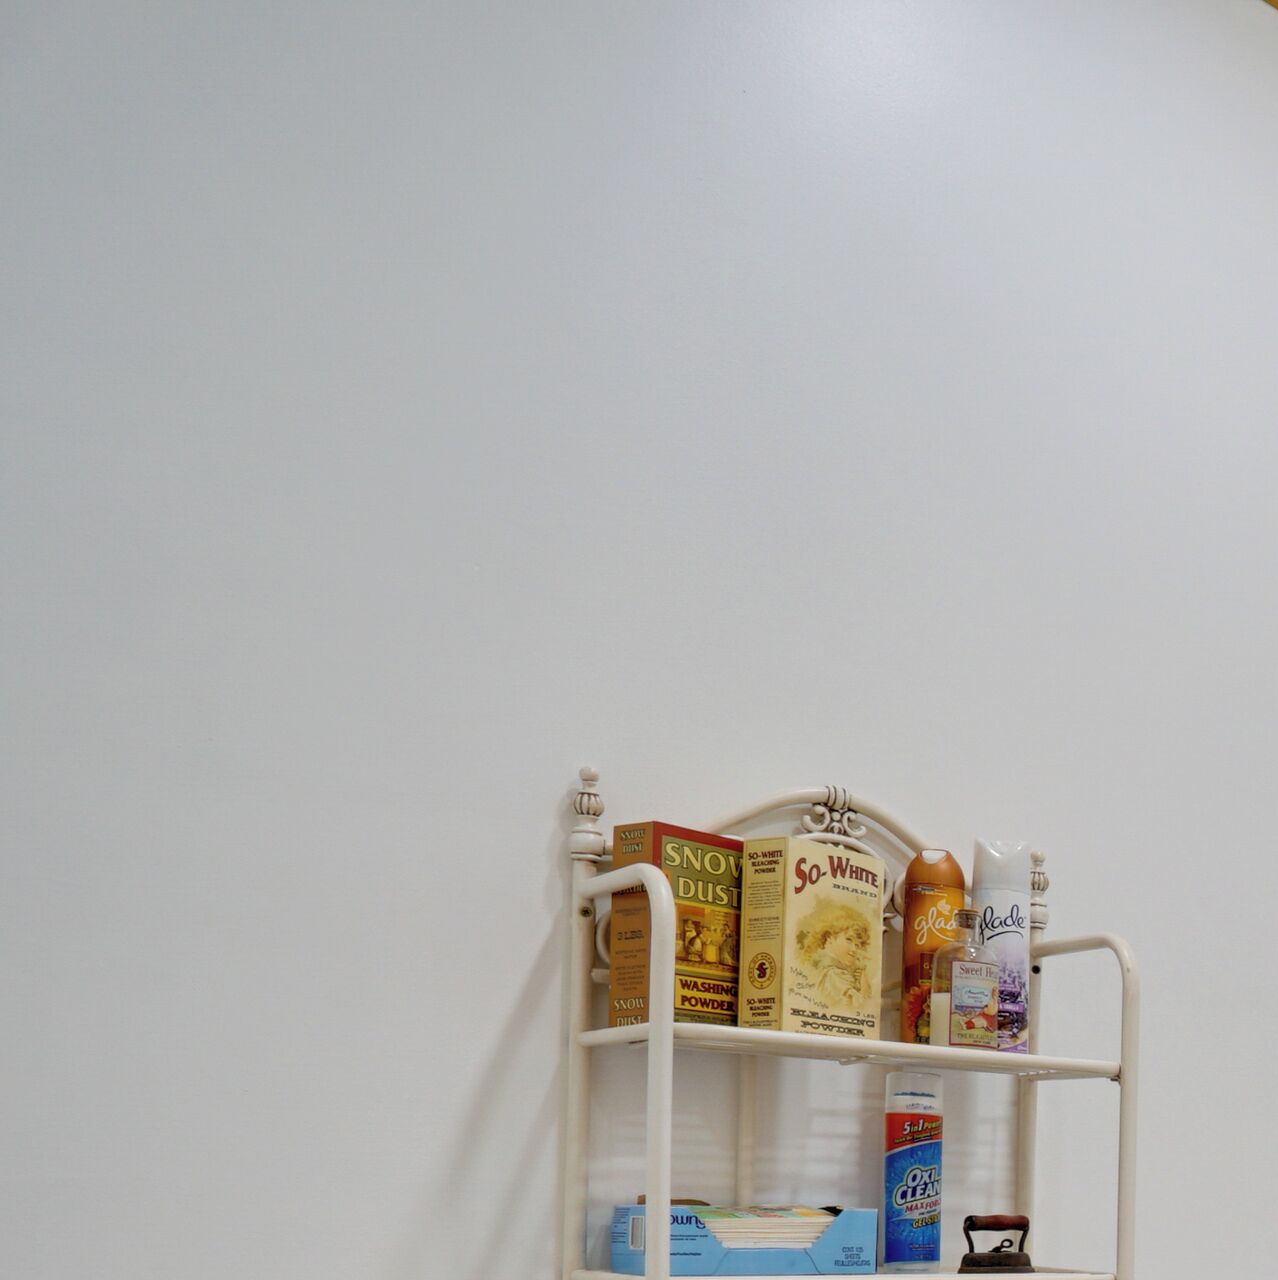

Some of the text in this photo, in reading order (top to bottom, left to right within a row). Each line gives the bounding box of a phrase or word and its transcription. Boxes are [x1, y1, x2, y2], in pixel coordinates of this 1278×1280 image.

[678, 876, 741, 907] DUST
[832, 883, 877, 898] BRAND
[679, 979, 738, 997] WASHING
[681, 995, 735, 1012] POWDER
[790, 1008, 875, 1027] BLEACHING
[800, 1020, 865, 1036] POWDER
[907, 1168, 935, 1187] OXI
[895, 1181, 940, 1205] CLEAN
[905, 1202, 924, 1213] MAX
